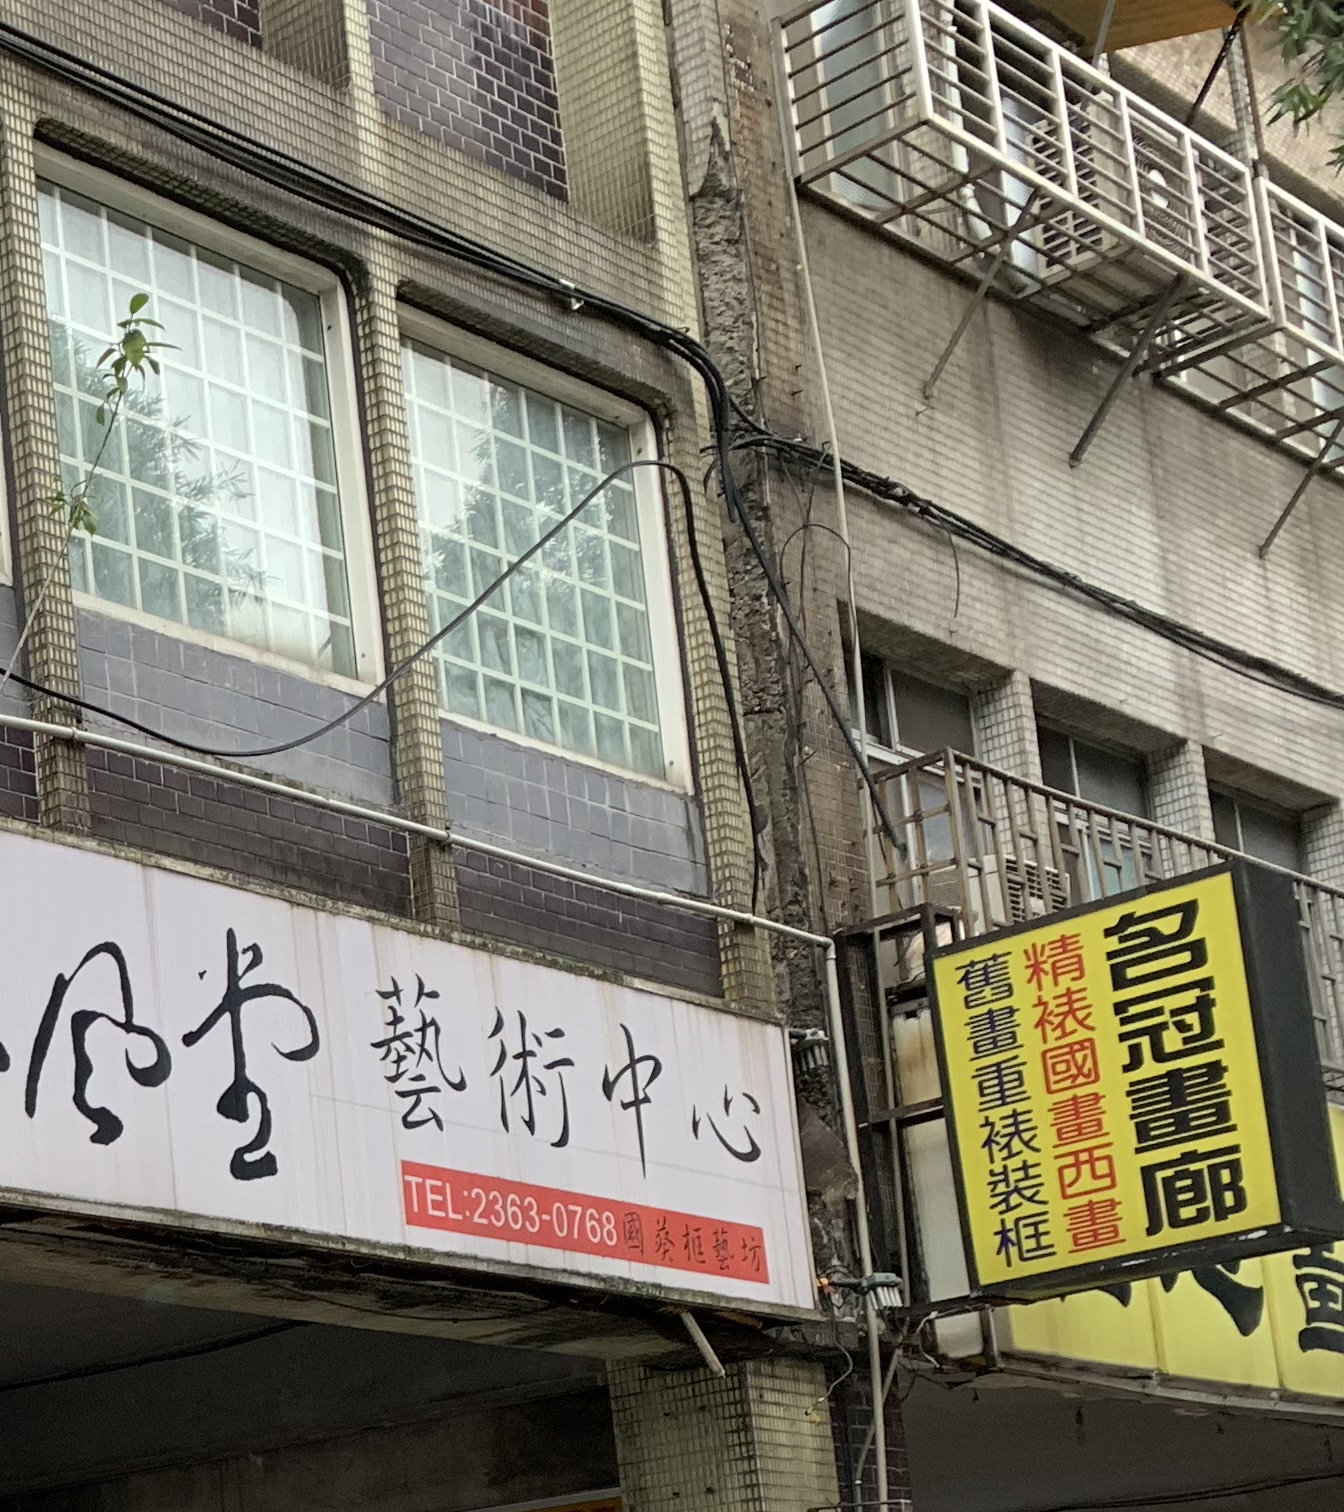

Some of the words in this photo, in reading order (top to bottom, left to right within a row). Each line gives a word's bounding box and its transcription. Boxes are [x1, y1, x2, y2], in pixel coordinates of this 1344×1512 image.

[367, 973, 762, 1179] 藝術中心
[403, 1174, 618, 1247] TEL:2363-0768
[954, 951, 1057, 1268] 舊畫重裱裝框
[1023, 931, 1127, 1255] 精裱國畫西畫
[1102, 898, 1248, 1237] 名冠畫廊
